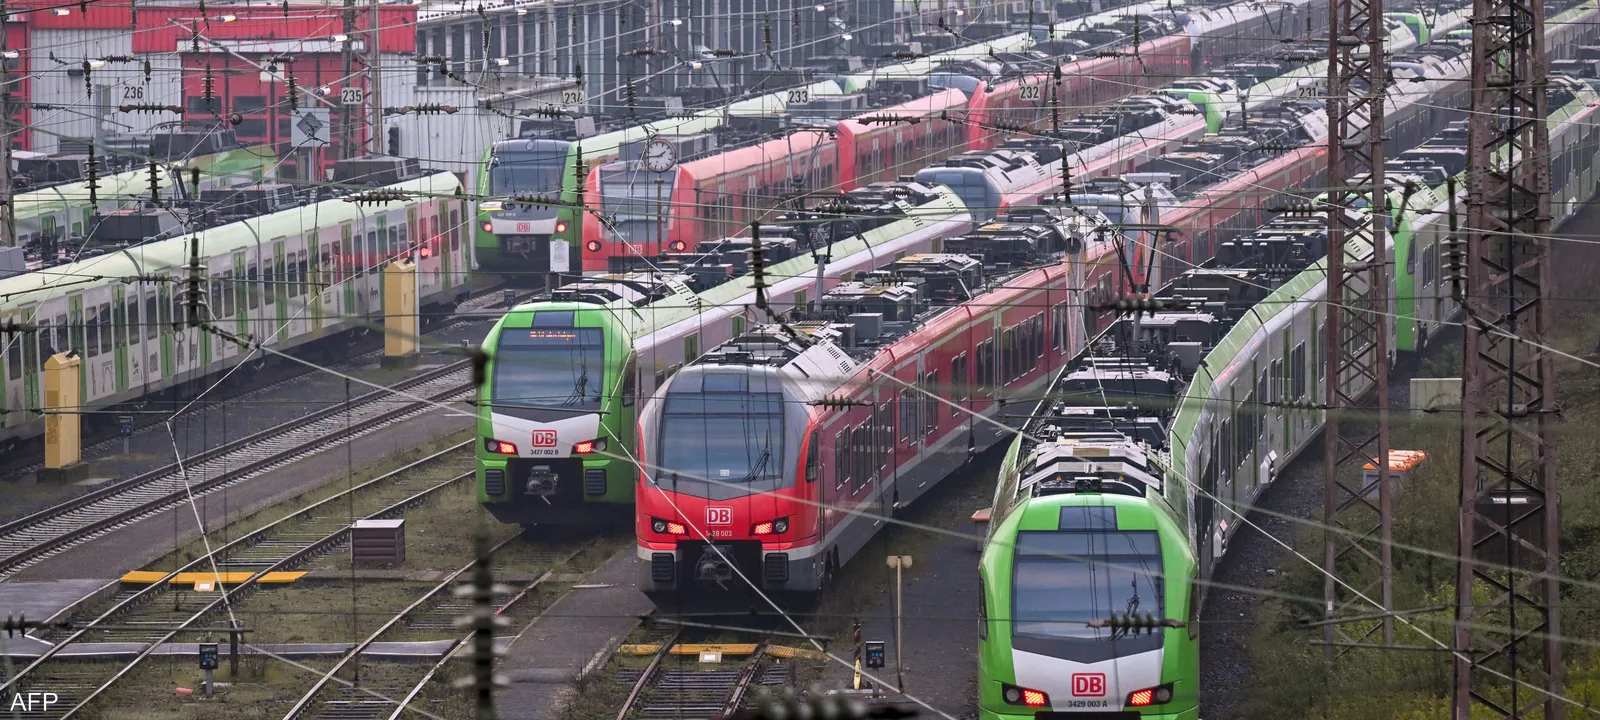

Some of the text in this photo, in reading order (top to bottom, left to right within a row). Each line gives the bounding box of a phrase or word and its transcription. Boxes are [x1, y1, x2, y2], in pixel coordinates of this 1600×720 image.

[124, 86, 143, 99] 236
[342, 89, 362, 102] 235
[788, 90, 808, 103] 233
[1020, 86, 1039, 99] 232
[1299, 87, 1316, 98] 231
[518, 223, 529, 232] DB
[534, 431, 555, 446] DB
[707, 508, 731, 523] DB
[1074, 675, 1103, 694] DB
